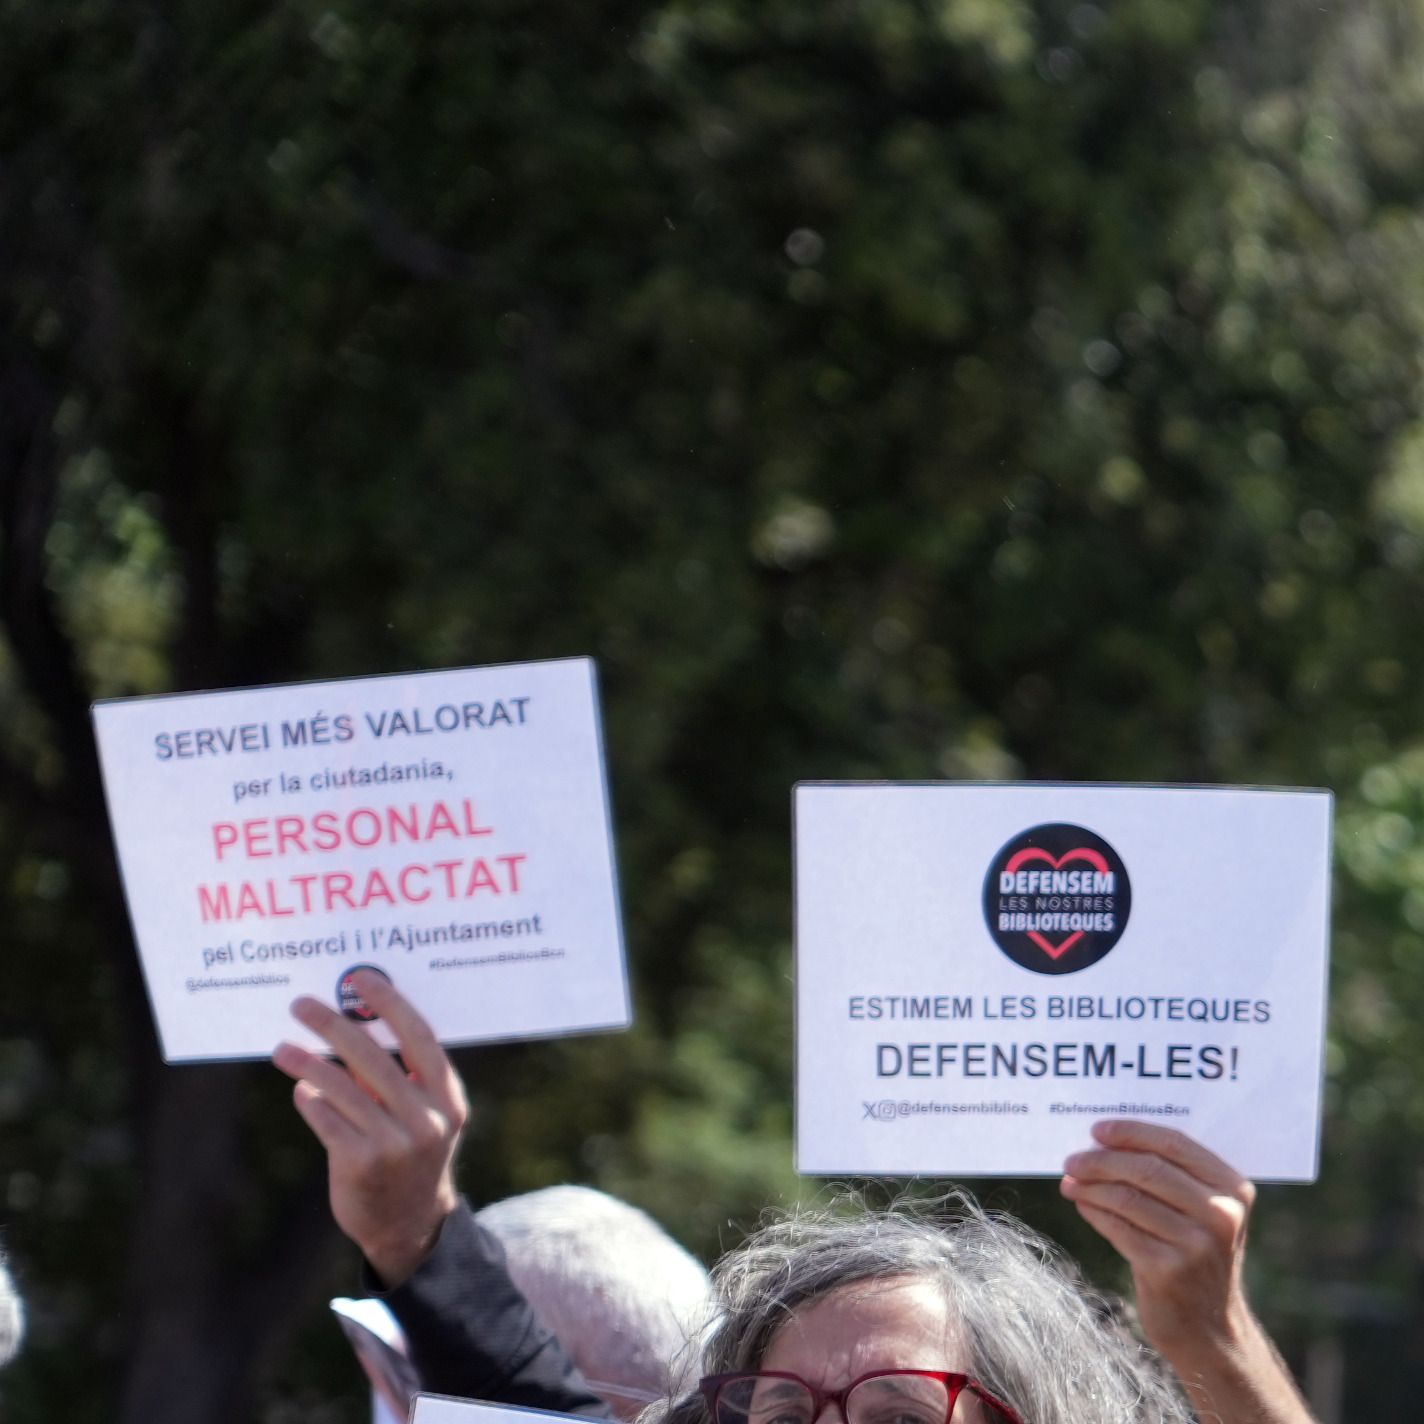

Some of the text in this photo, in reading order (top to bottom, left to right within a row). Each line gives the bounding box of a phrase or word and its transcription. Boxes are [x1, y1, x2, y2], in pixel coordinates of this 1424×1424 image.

[154, 697, 532, 760] SERVEI MÉS VALORAT
[233, 760, 454, 802] per la ciutadania,
[211, 799, 493, 860] PERSONAL
[197, 854, 528, 924] MALTRACTAT
[1000, 871, 1114, 894] DEFENSEM
[998, 912, 1114, 931] BIBLIOTEQUES
[1000, 896, 1115, 911] LES NOSTRES
[203, 915, 542, 968] pel Consorci i l'Ajuntament
[849, 996, 1270, 1023] ESTIMEM LES BIBLIOTEQUES
[876, 1043, 1240, 1082] DEFENSEM-LES!
